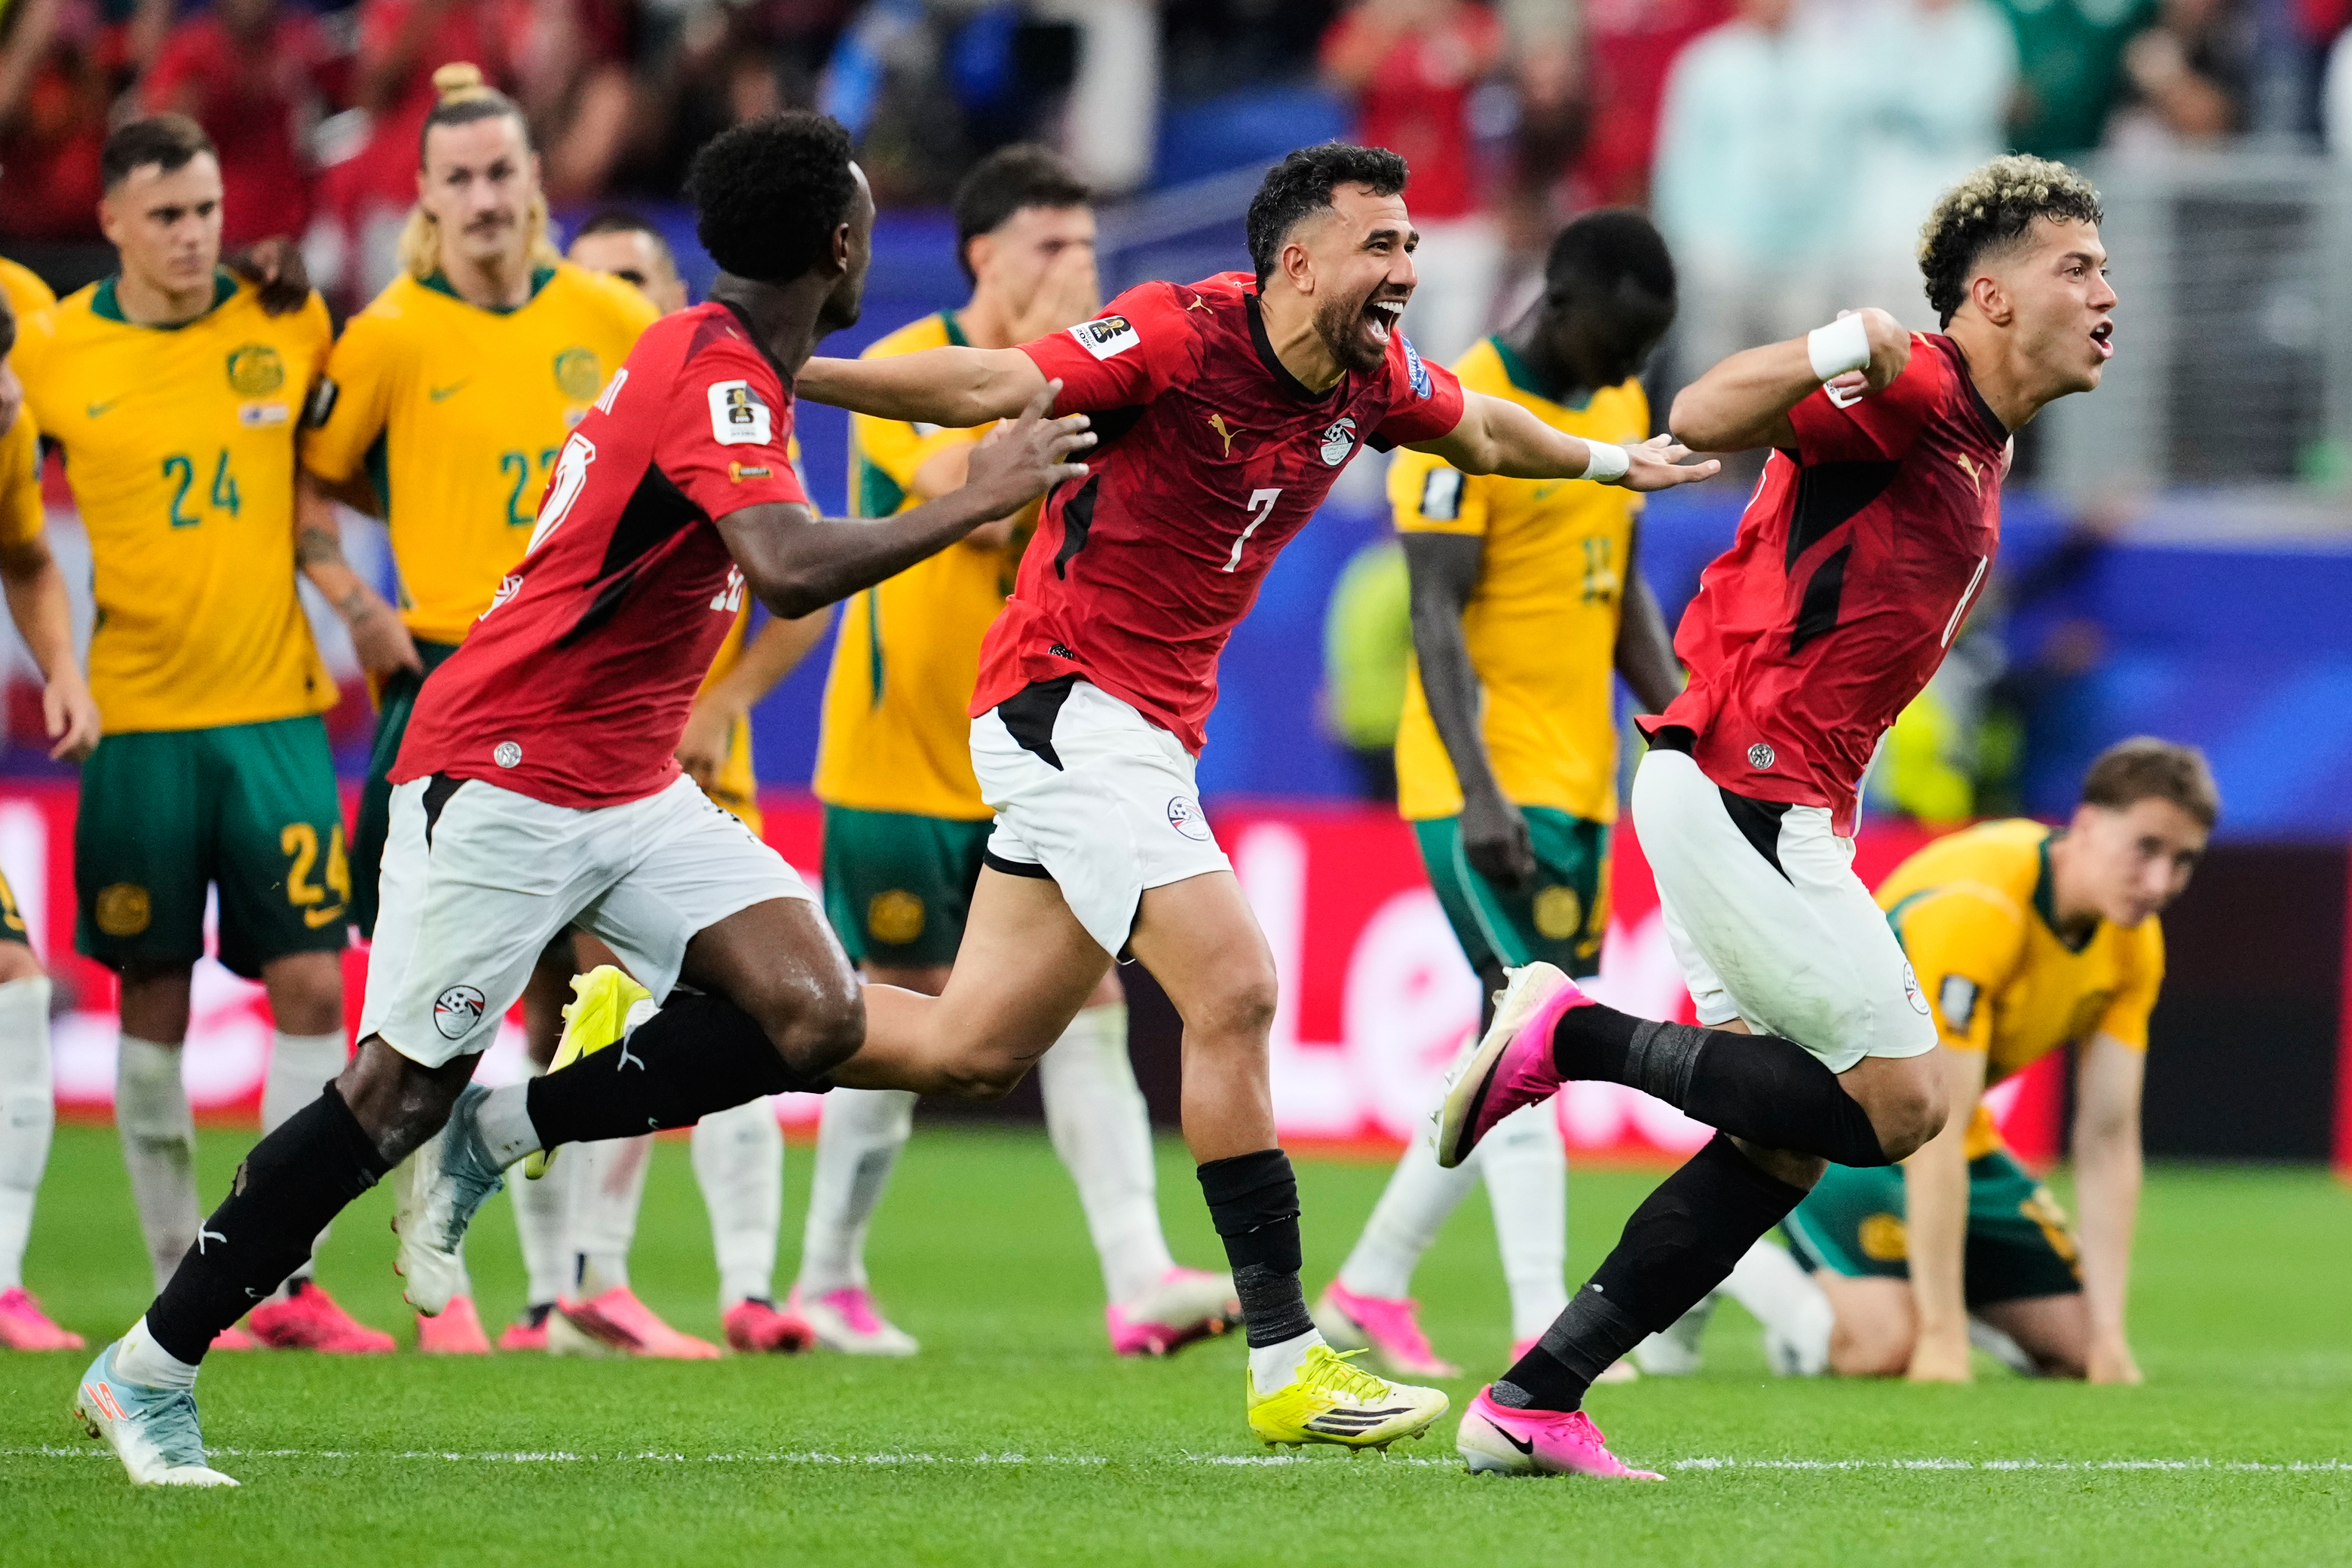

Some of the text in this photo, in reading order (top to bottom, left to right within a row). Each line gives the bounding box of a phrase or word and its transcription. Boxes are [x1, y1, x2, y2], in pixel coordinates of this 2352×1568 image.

[1076, 328, 1093, 350] 2026
[162, 449, 241, 527] 24
[1222, 488, 1283, 573] 7
[1940, 554, 1988, 648] 8
[282, 822, 352, 906] 24
